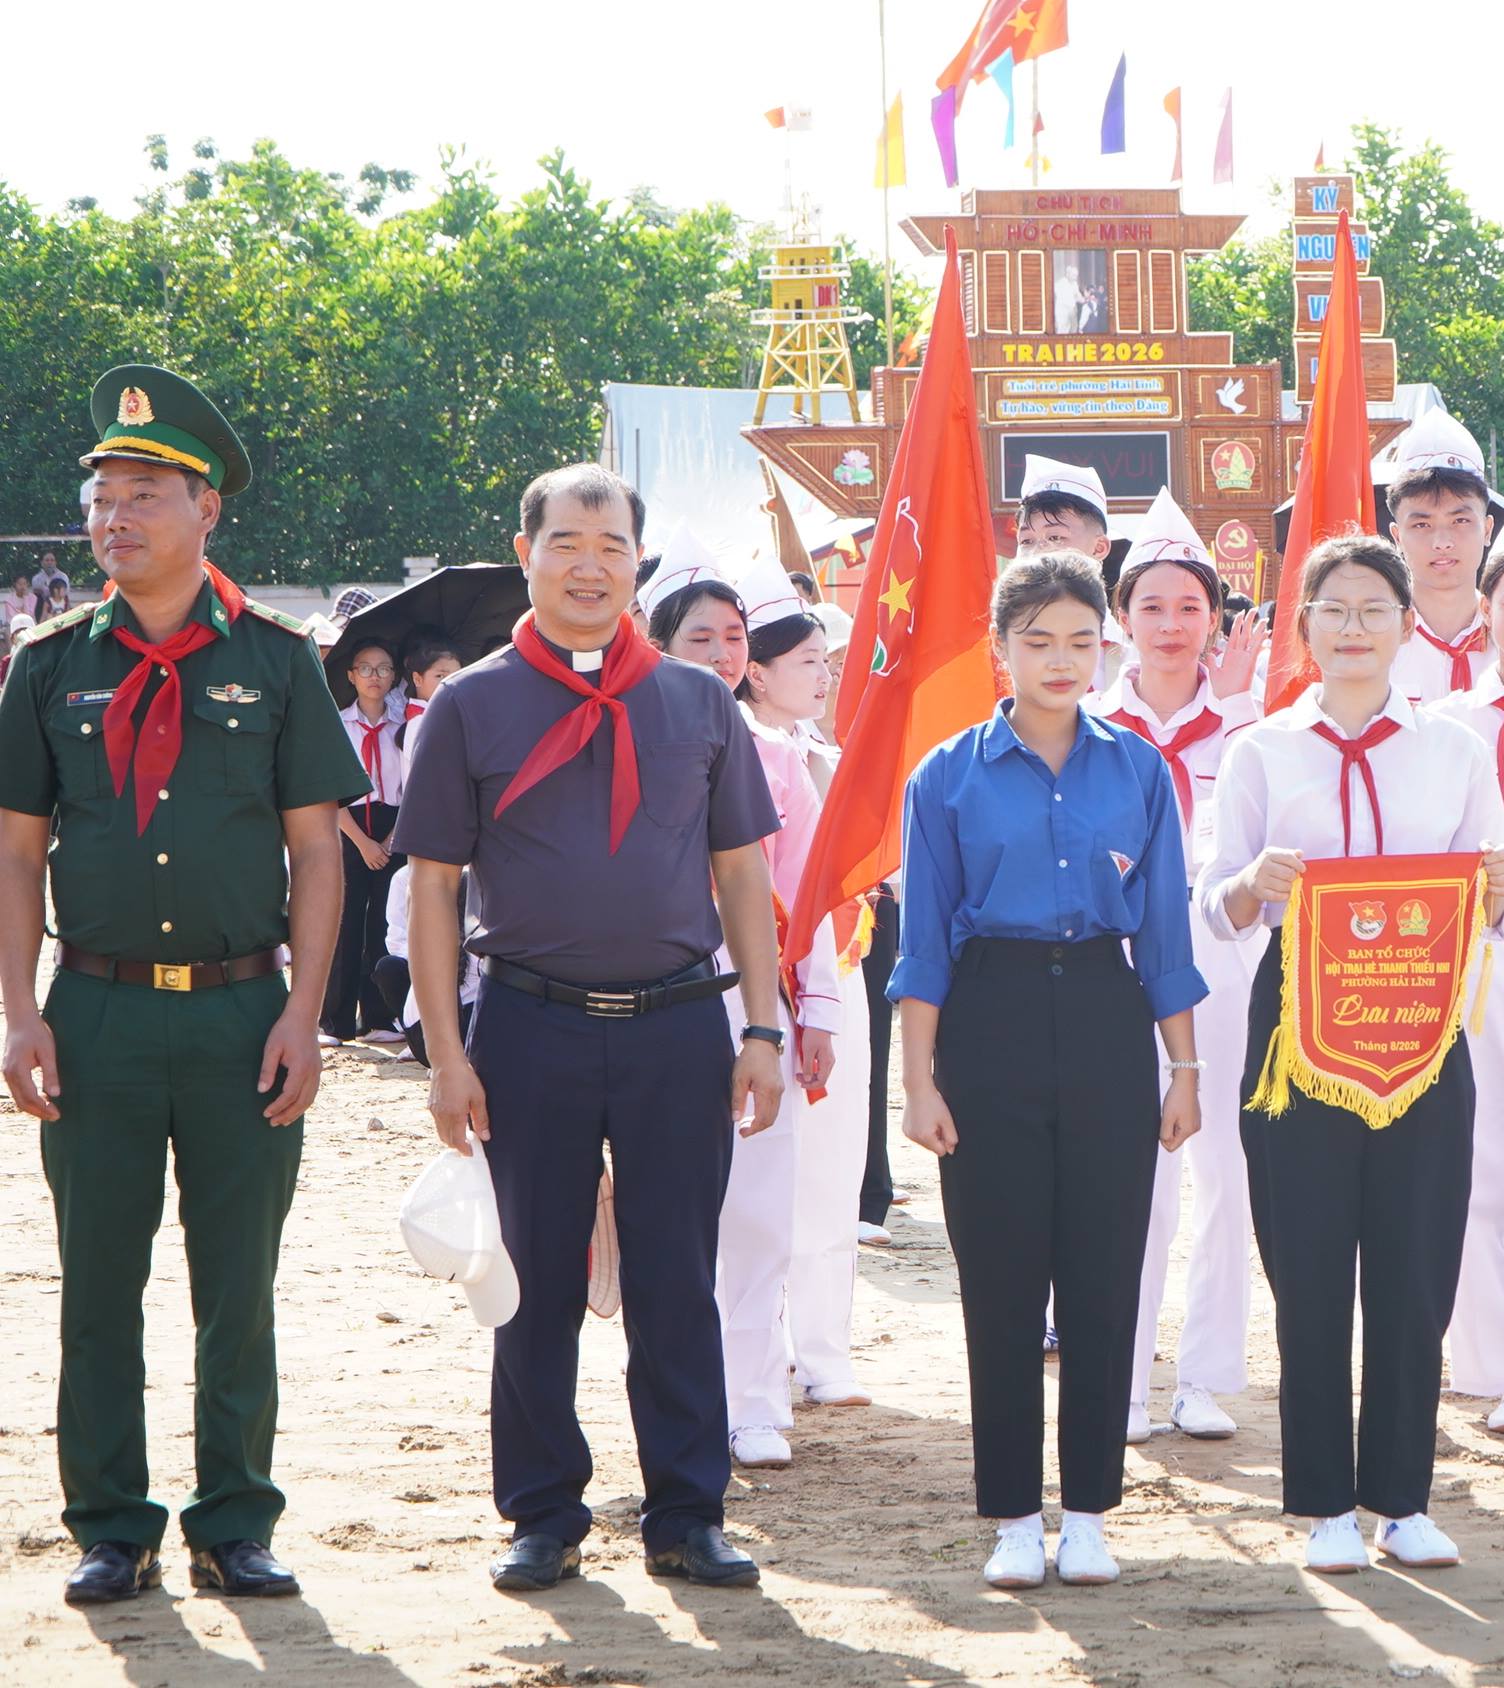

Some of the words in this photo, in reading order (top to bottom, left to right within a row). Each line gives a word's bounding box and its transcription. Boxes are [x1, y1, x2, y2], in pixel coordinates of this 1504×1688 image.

[1297, 234, 1370, 261] NGUN
[1002, 343, 1064, 366] TRẠI
[1066, 339, 1097, 362] HÈ
[1100, 342, 1164, 361] 2026
[1347, 949, 1374, 959] BAN
[1396, 945, 1431, 958] CHỨC
[1325, 961, 1341, 976] HỘI
[1343, 963, 1362, 977] TRẠI
[1378, 962, 1409, 974] THANH
[1410, 959, 1434, 974] THIẾU
[1341, 975, 1388, 987] PHƯỜNG
[1389, 974, 1408, 987] HẢI
[1411, 976, 1436, 987] LĨNH
[1332, 993, 1390, 1026] Lưu
[1394, 1000, 1442, 1028] niệm
[1353, 1040, 1388, 1053] Tháng
[1390, 1040, 1421, 1051] 8/2026
